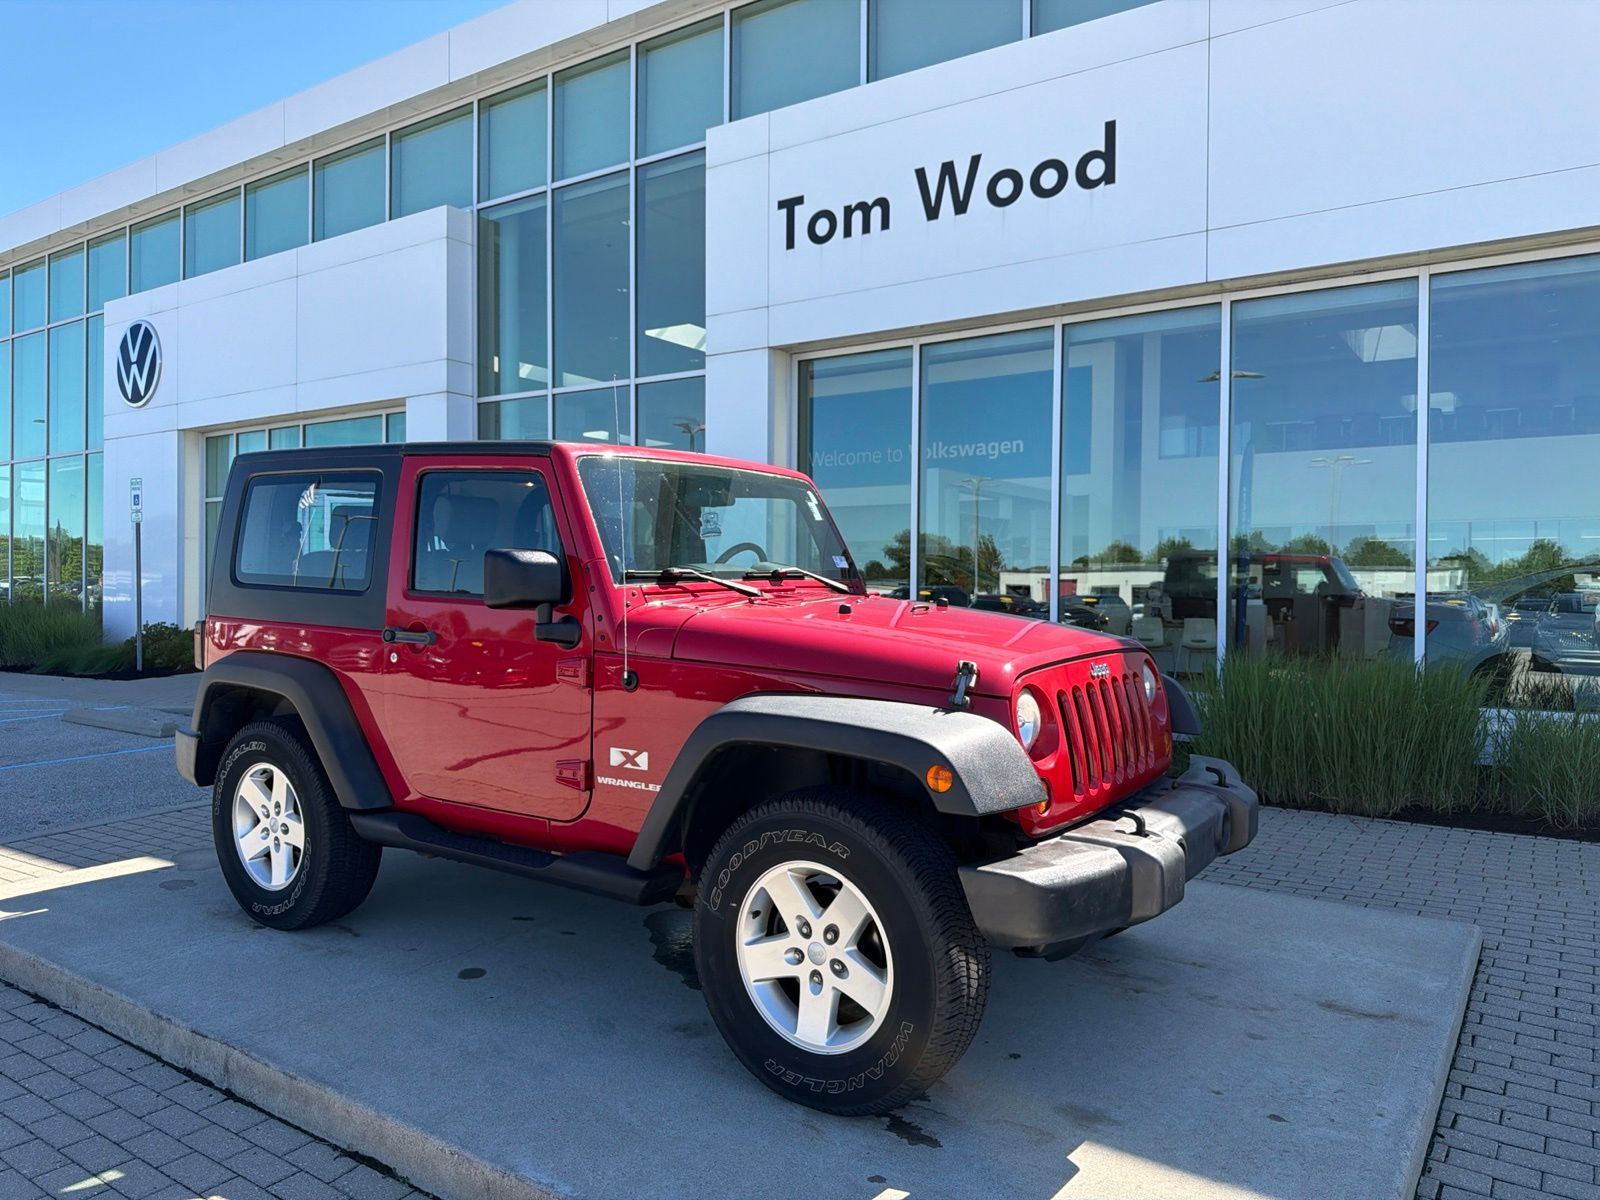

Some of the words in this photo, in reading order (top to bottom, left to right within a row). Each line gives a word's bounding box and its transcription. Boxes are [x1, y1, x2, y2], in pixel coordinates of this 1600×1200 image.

[777, 194, 891, 251] Tom
[914, 119, 1117, 222] Wood
[117, 320, 162, 408] VW
[808, 448, 881, 467] Welcome
[887, 447, 903, 463] to
[908, 439, 1024, 460] lkswagen
[251, 837, 312, 915] GOODYEAR
[710, 829, 851, 911] GOODYEAR
[763, 1021, 914, 1094] WRANGLER
